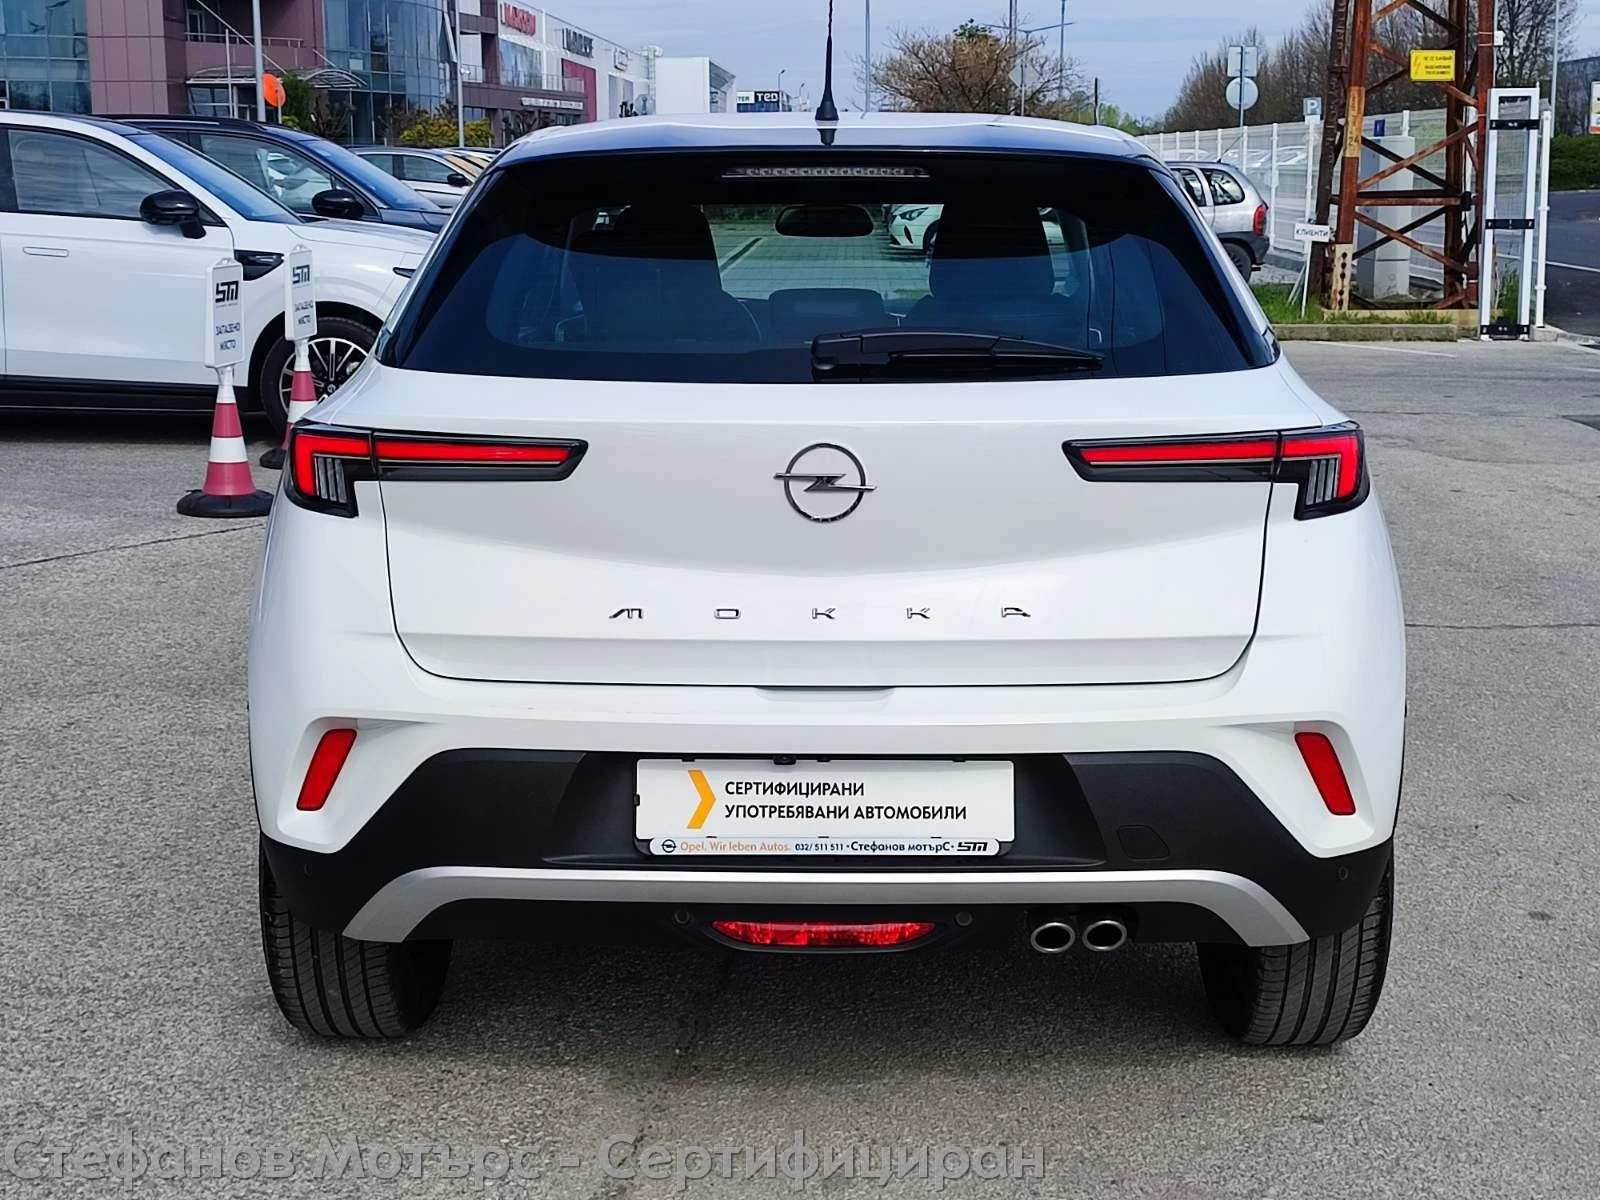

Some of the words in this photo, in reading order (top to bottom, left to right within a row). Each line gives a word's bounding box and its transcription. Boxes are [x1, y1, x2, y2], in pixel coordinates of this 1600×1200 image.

[1307, 100, 1317, 113] P
[608, 606, 1032, 620] MOKKA
[725, 781, 865, 798] СЕРТИФИЦИРАНИ
[725, 804, 850, 820] УПОТРЕБЯВАНИ
[853, 805, 967, 820] АВТОМОБИЛИ
[709, 841, 729, 852] Wir
[729, 841, 757, 852] leben
[814, 843, 828, 852] 511
[830, 843, 844, 852] 511
